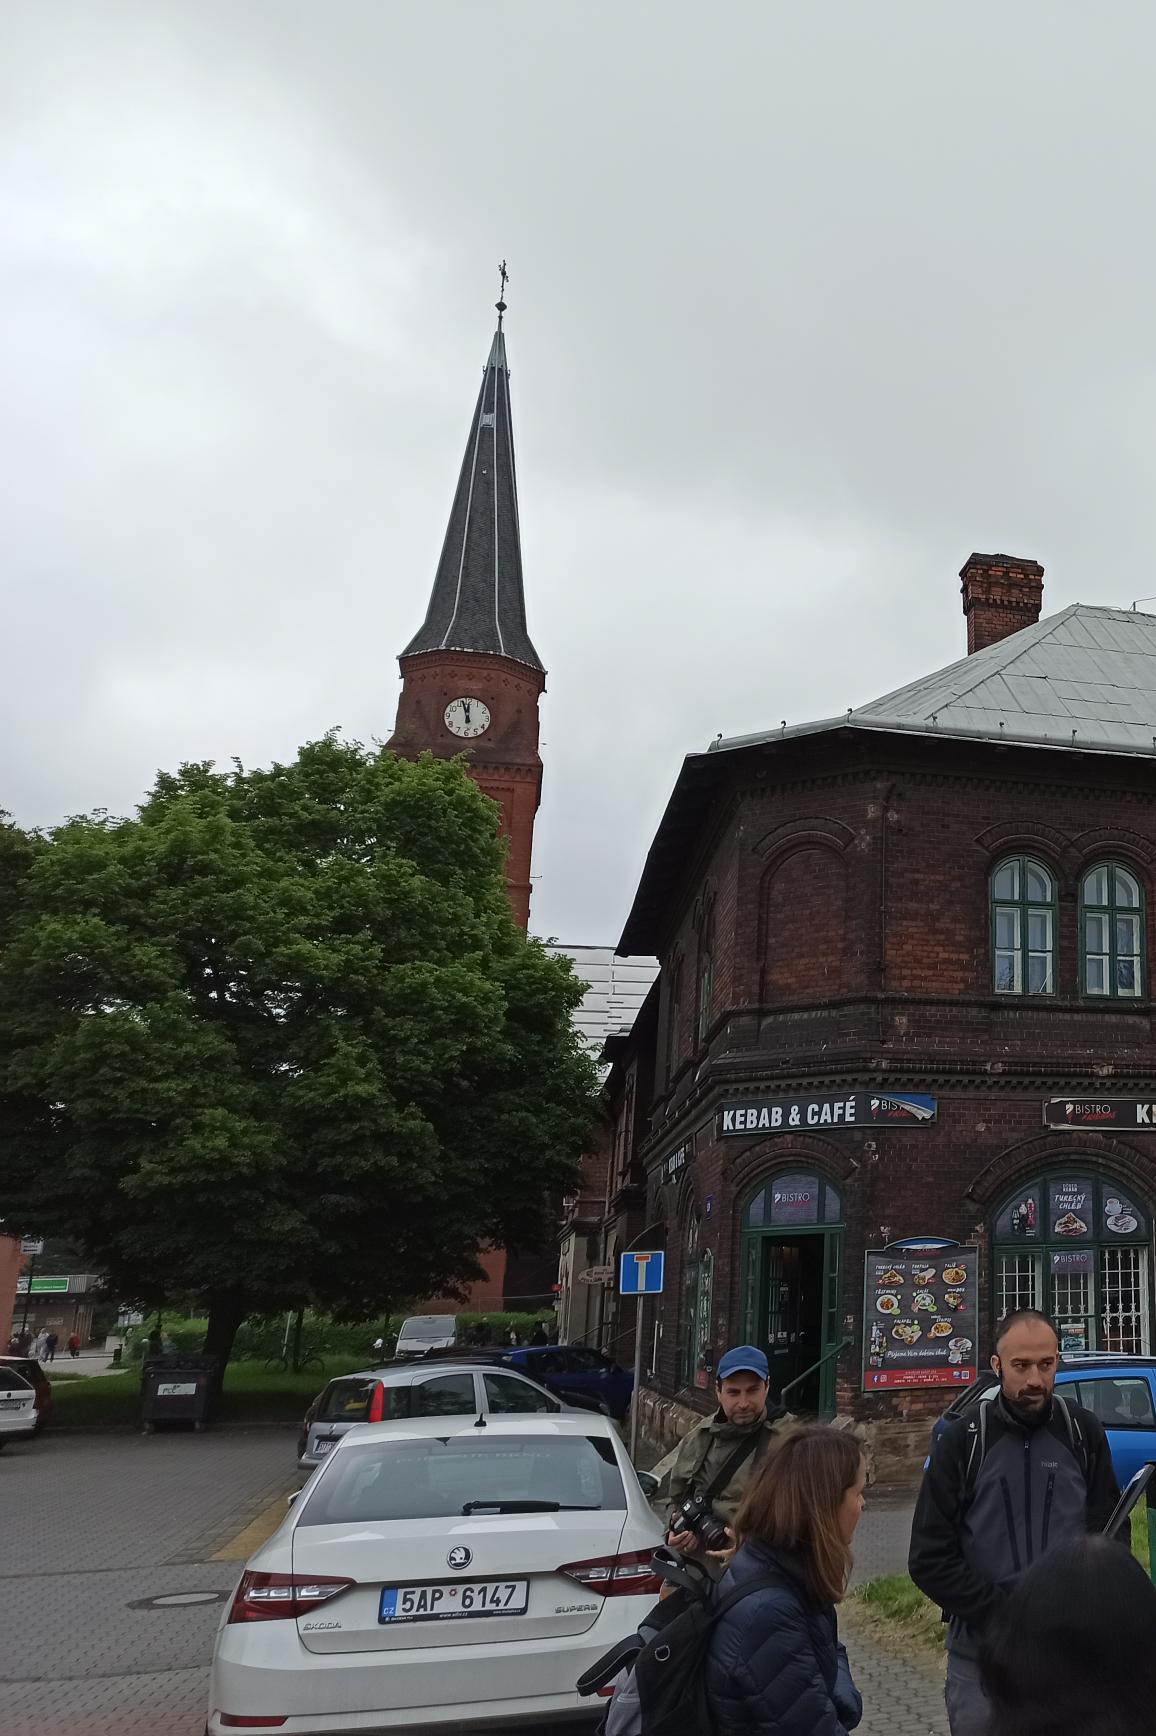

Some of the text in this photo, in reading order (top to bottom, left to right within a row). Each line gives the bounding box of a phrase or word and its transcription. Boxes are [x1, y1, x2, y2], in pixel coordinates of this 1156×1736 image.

[722, 1095, 857, 1132] KEBAB & CAFÉ
[1075, 1103, 1111, 1115] BISTRO
[781, 1192, 810, 1202] BISTRO
[1054, 1193, 1087, 1203] TURECKÝ
[1061, 1254, 1088, 1263] BISTRO
[401, 1583, 516, 1613] 5AP 6147
[383, 1606, 394, 1615] CZ
[554, 1603, 598, 1614] SUPERB
